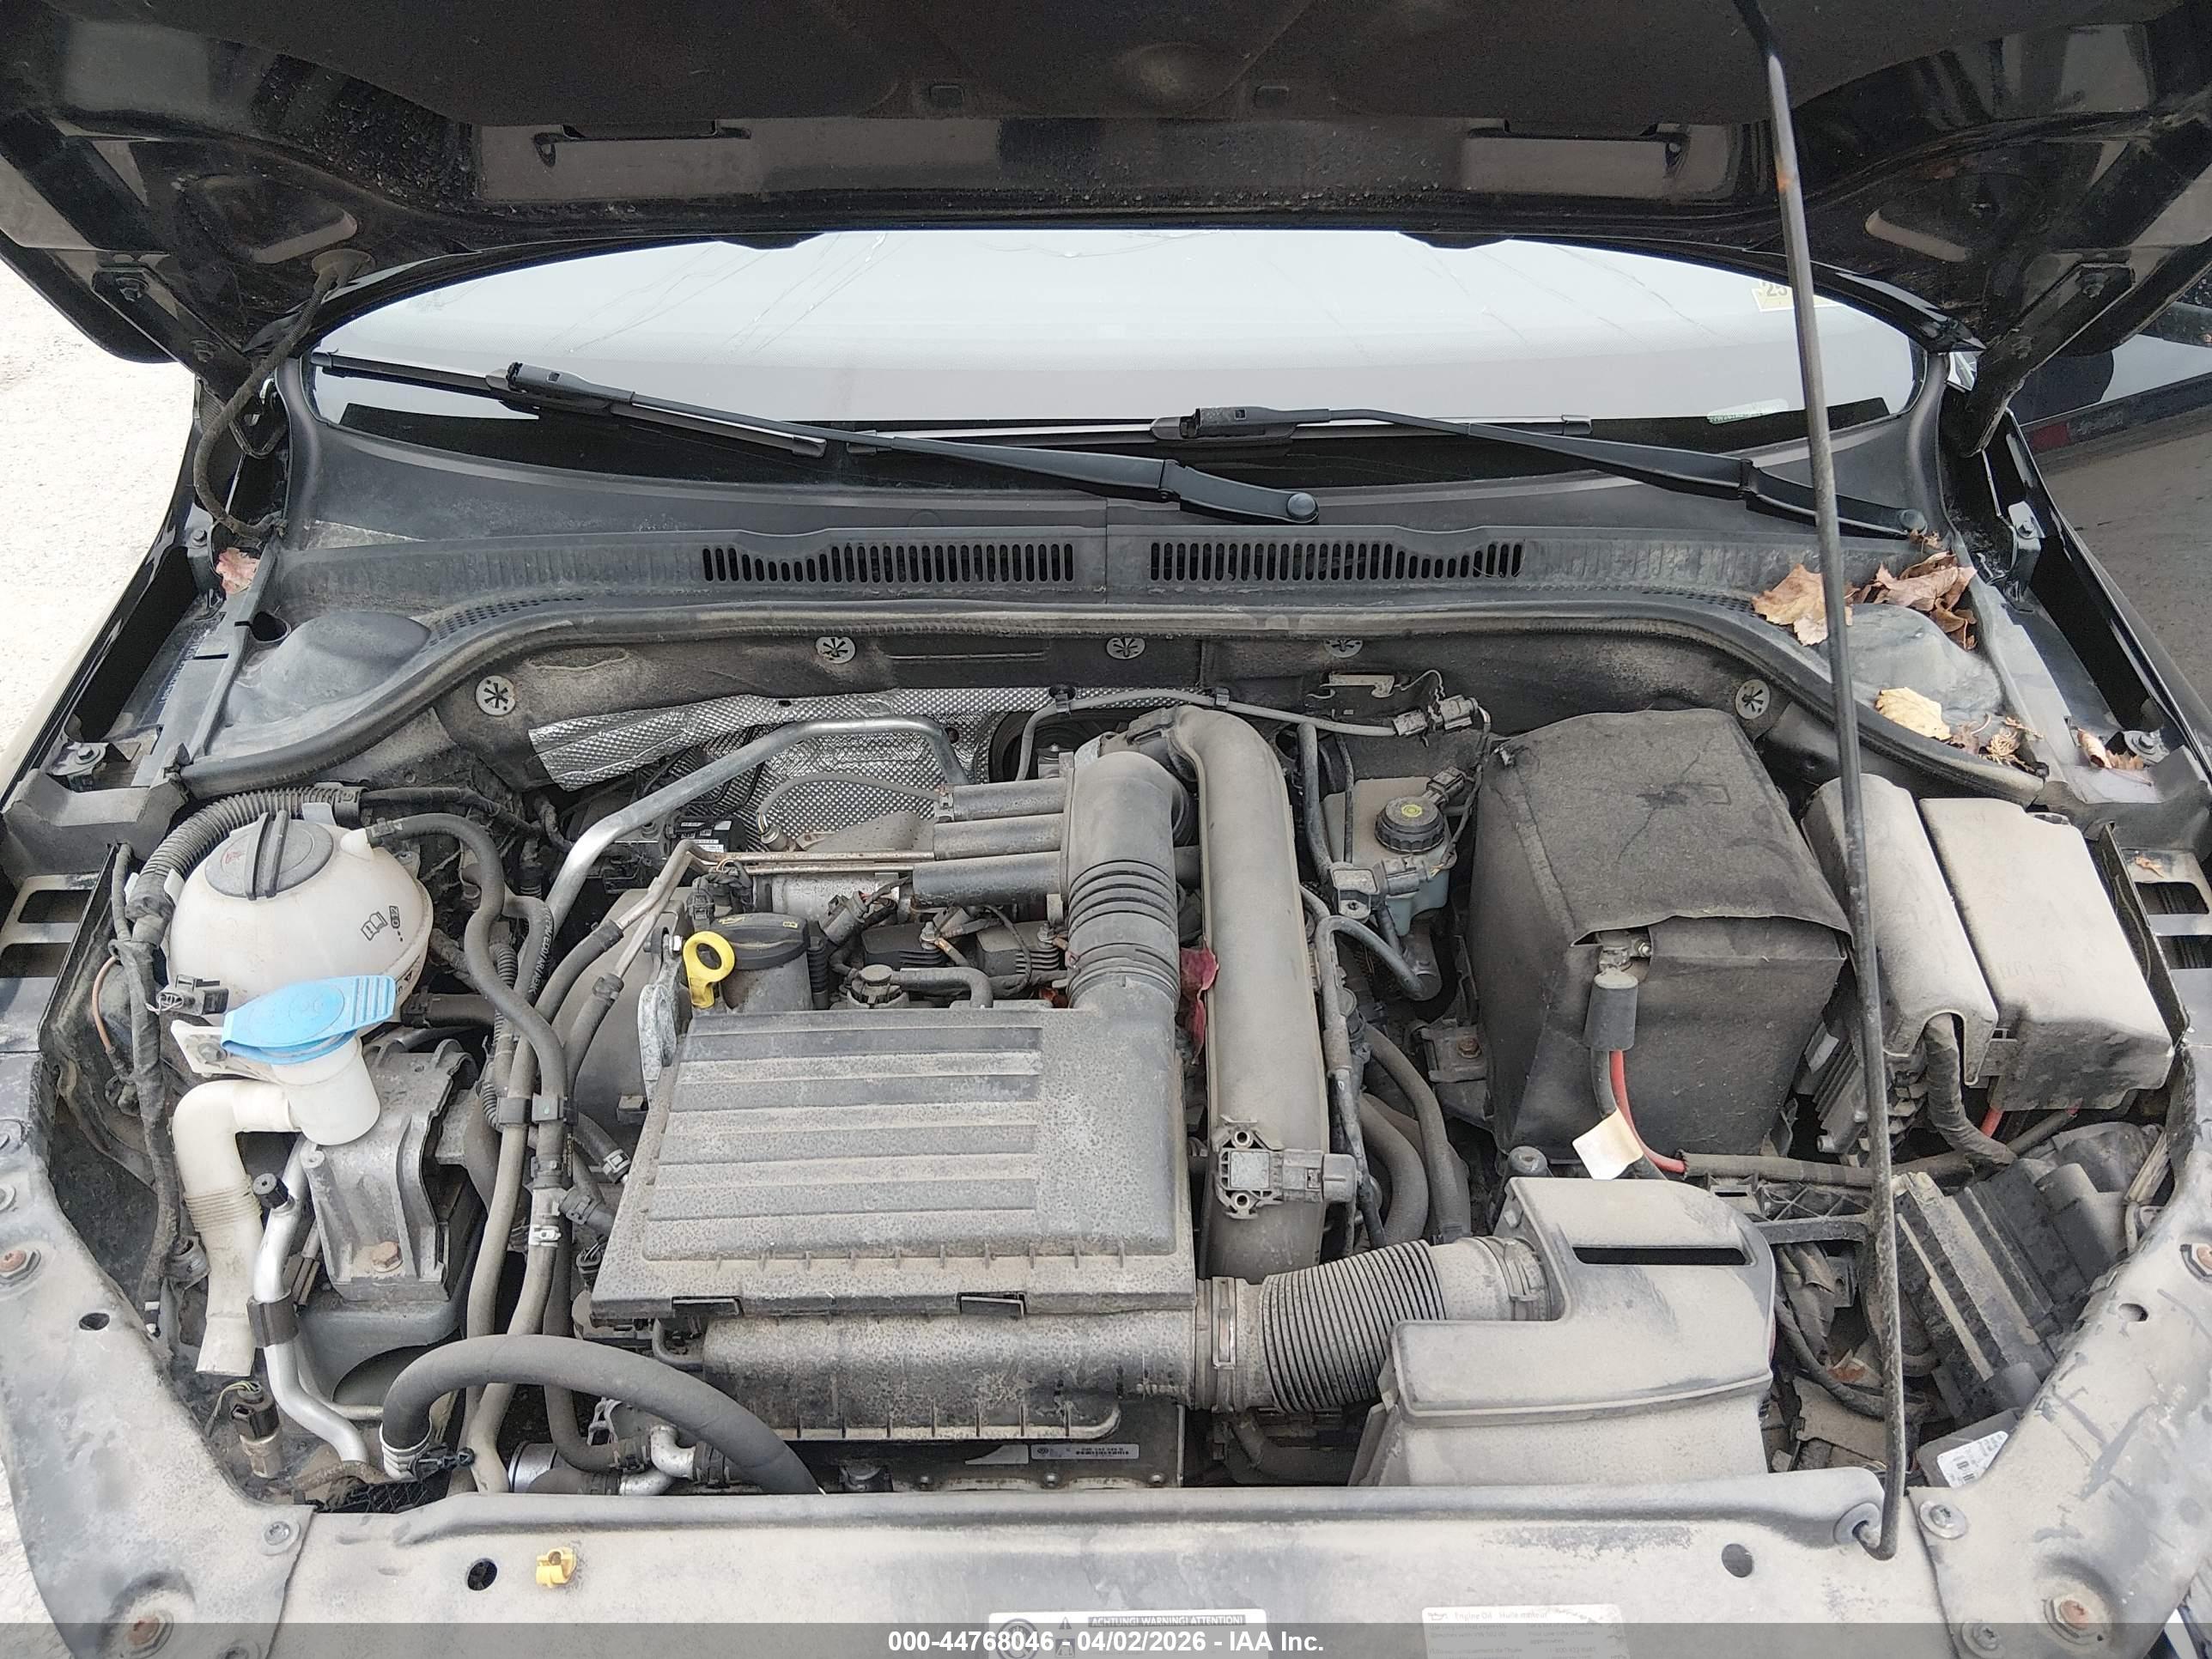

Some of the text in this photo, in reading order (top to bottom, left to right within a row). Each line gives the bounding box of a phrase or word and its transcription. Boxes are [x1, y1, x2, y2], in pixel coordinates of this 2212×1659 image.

[1092, 1615, 1243, 1627] ACHTUNG! WARNING! ATTENTION!
